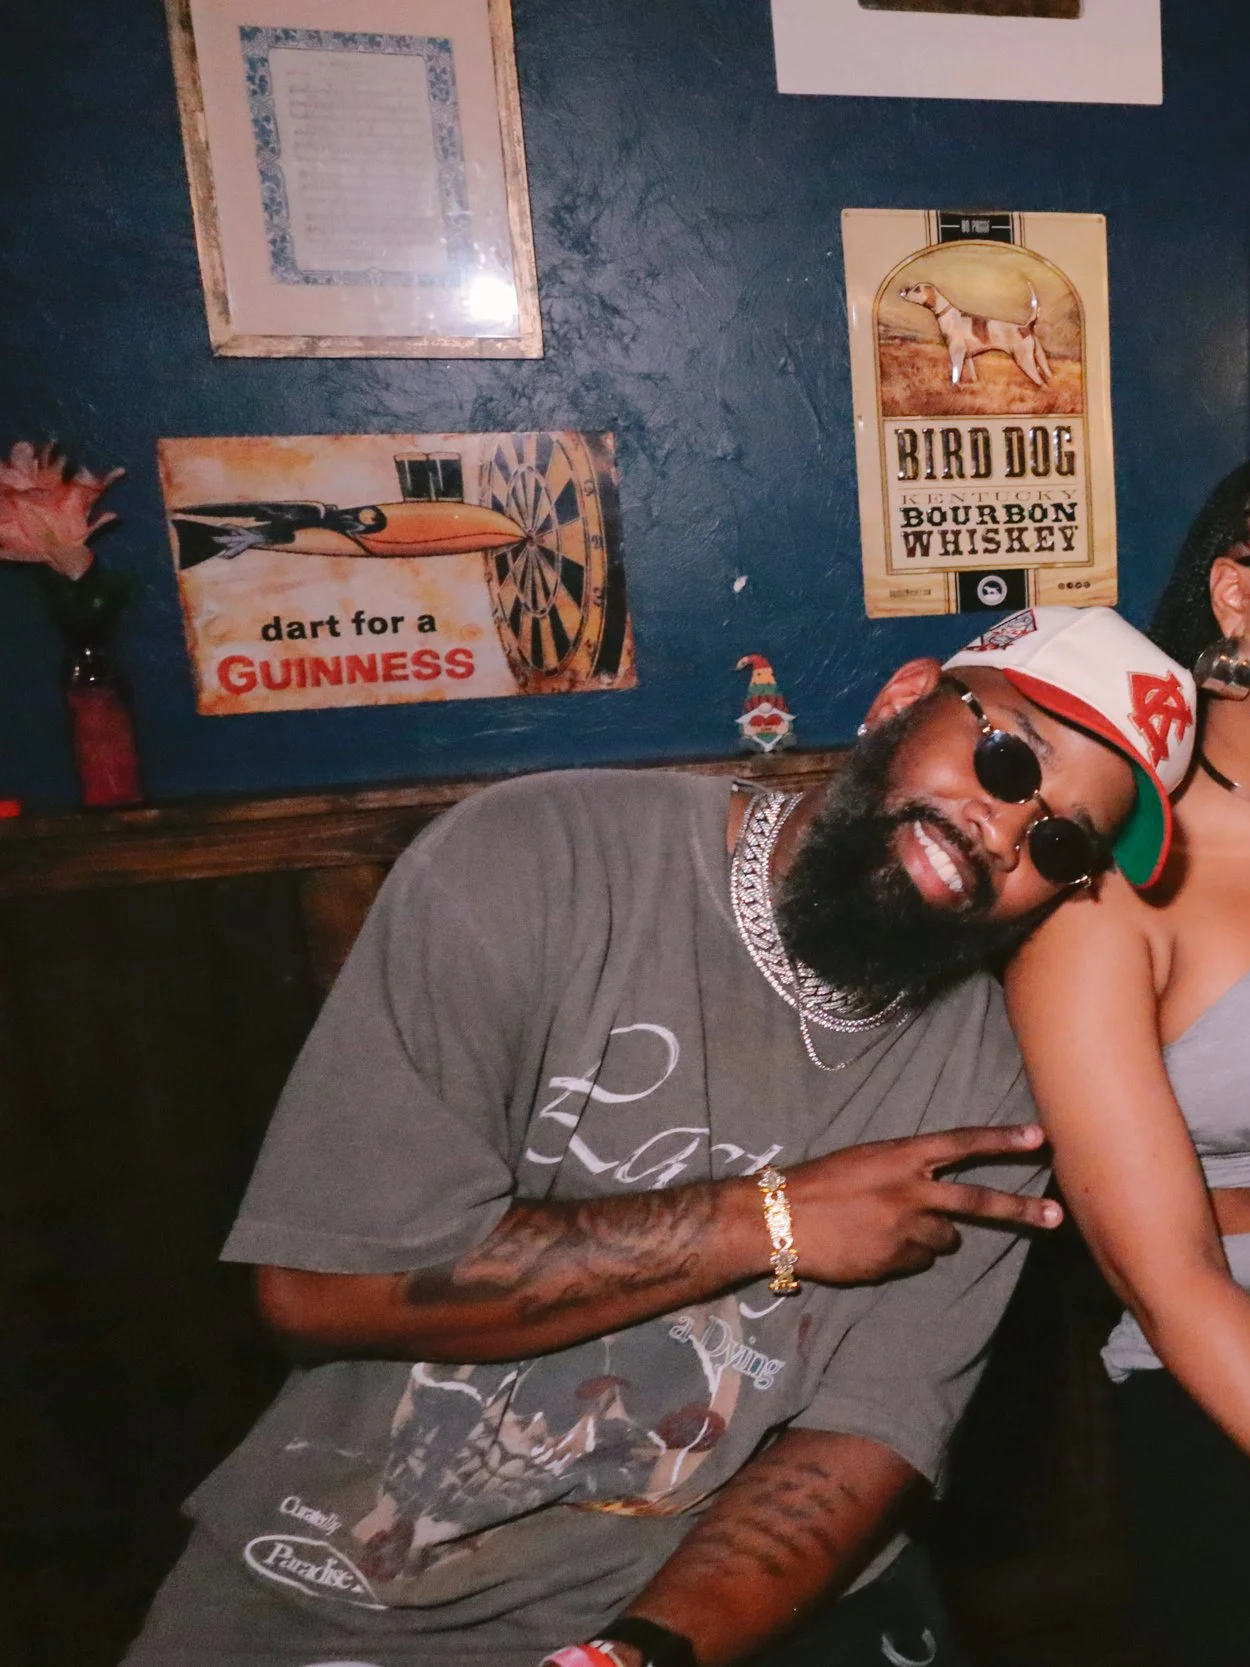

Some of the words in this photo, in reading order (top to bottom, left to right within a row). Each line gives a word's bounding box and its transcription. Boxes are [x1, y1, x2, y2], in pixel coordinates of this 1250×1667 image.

[895, 426, 994, 481] BIRD
[1002, 425, 1076, 478] DOG
[902, 489, 1078, 505] KENTUCKY
[900, 502, 1079, 528] BOURBON
[900, 525, 1079, 558] WHISKEY
[260, 615, 341, 642] dart
[351, 610, 405, 636] for
[416, 613, 437, 634] a
[216, 647, 476, 695] GUINNESS
[668, 1315, 694, 1343] a
[700, 1315, 787, 1390] Dying
